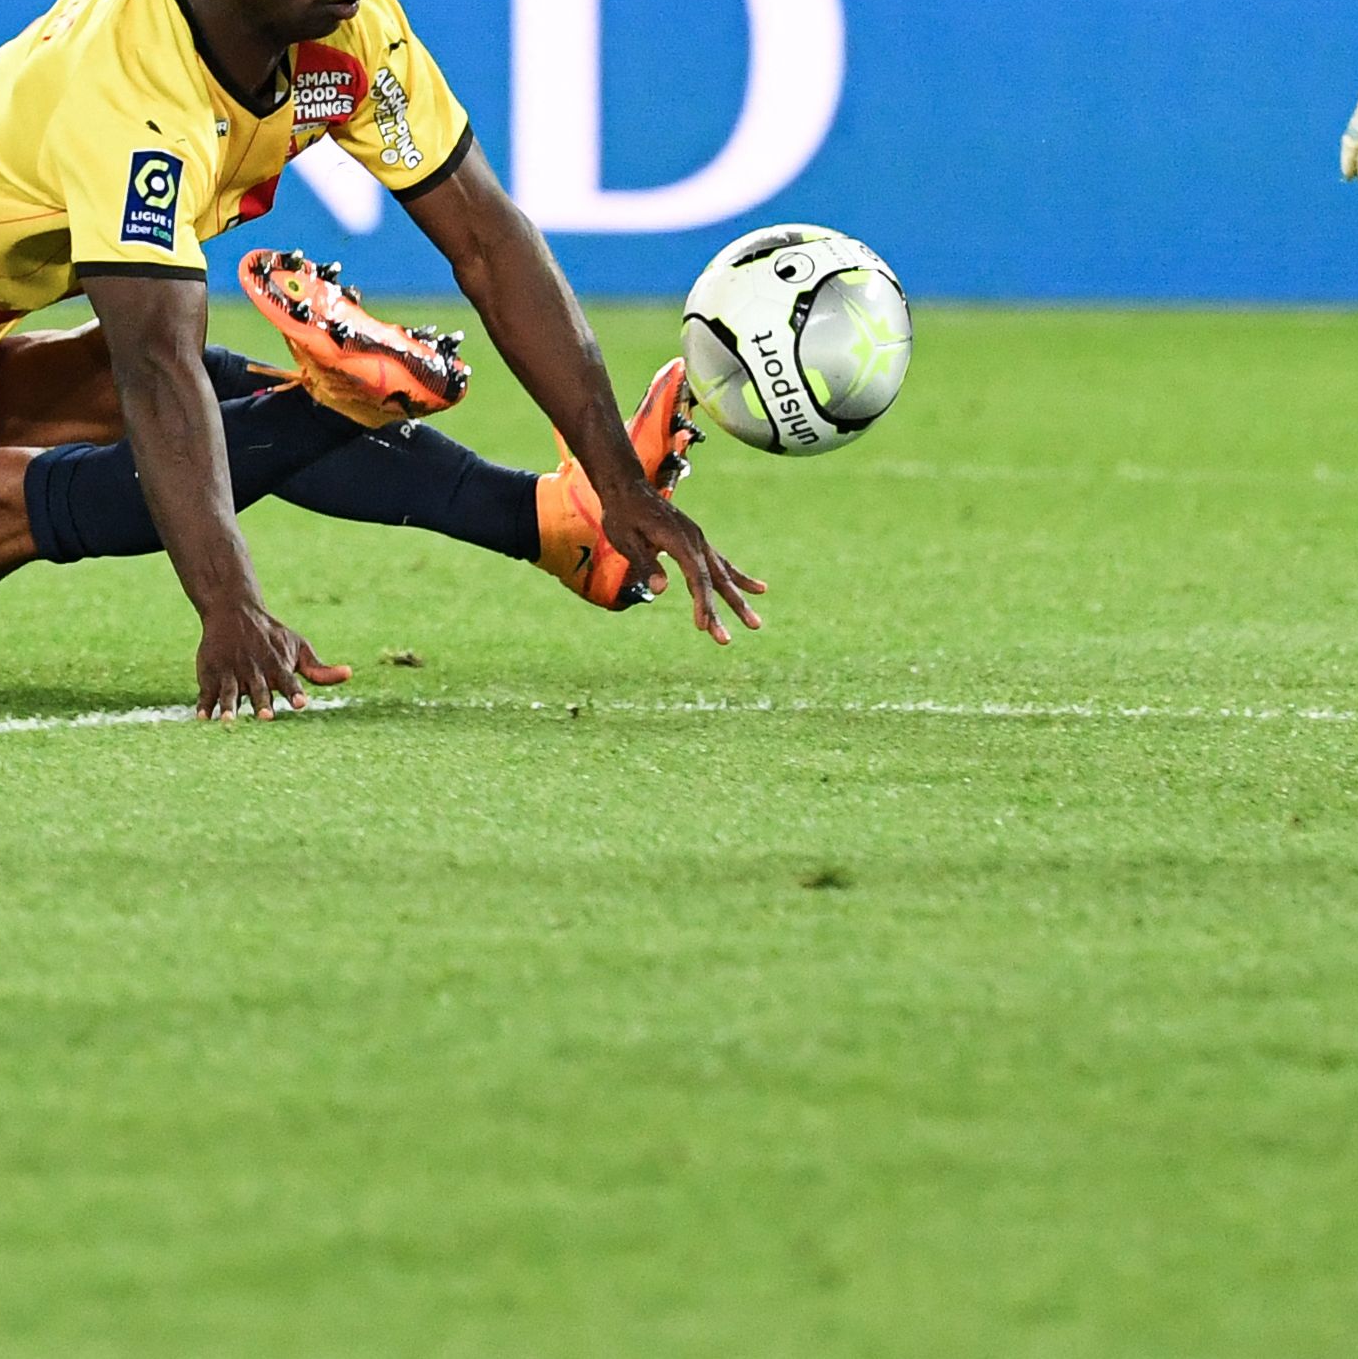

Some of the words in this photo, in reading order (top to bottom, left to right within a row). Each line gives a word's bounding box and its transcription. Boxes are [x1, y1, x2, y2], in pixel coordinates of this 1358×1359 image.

[297, 72, 353, 88] SMART
[292, 87, 338, 105] GOOD
[293, 101, 353, 120] THINGS
[131, 210, 167, 226] LIGUE
[167, 218, 172, 228] 1
[125, 224, 152, 235] Uber
[152, 225, 172, 242] Eats
[751, 329, 820, 446] uhlsport
